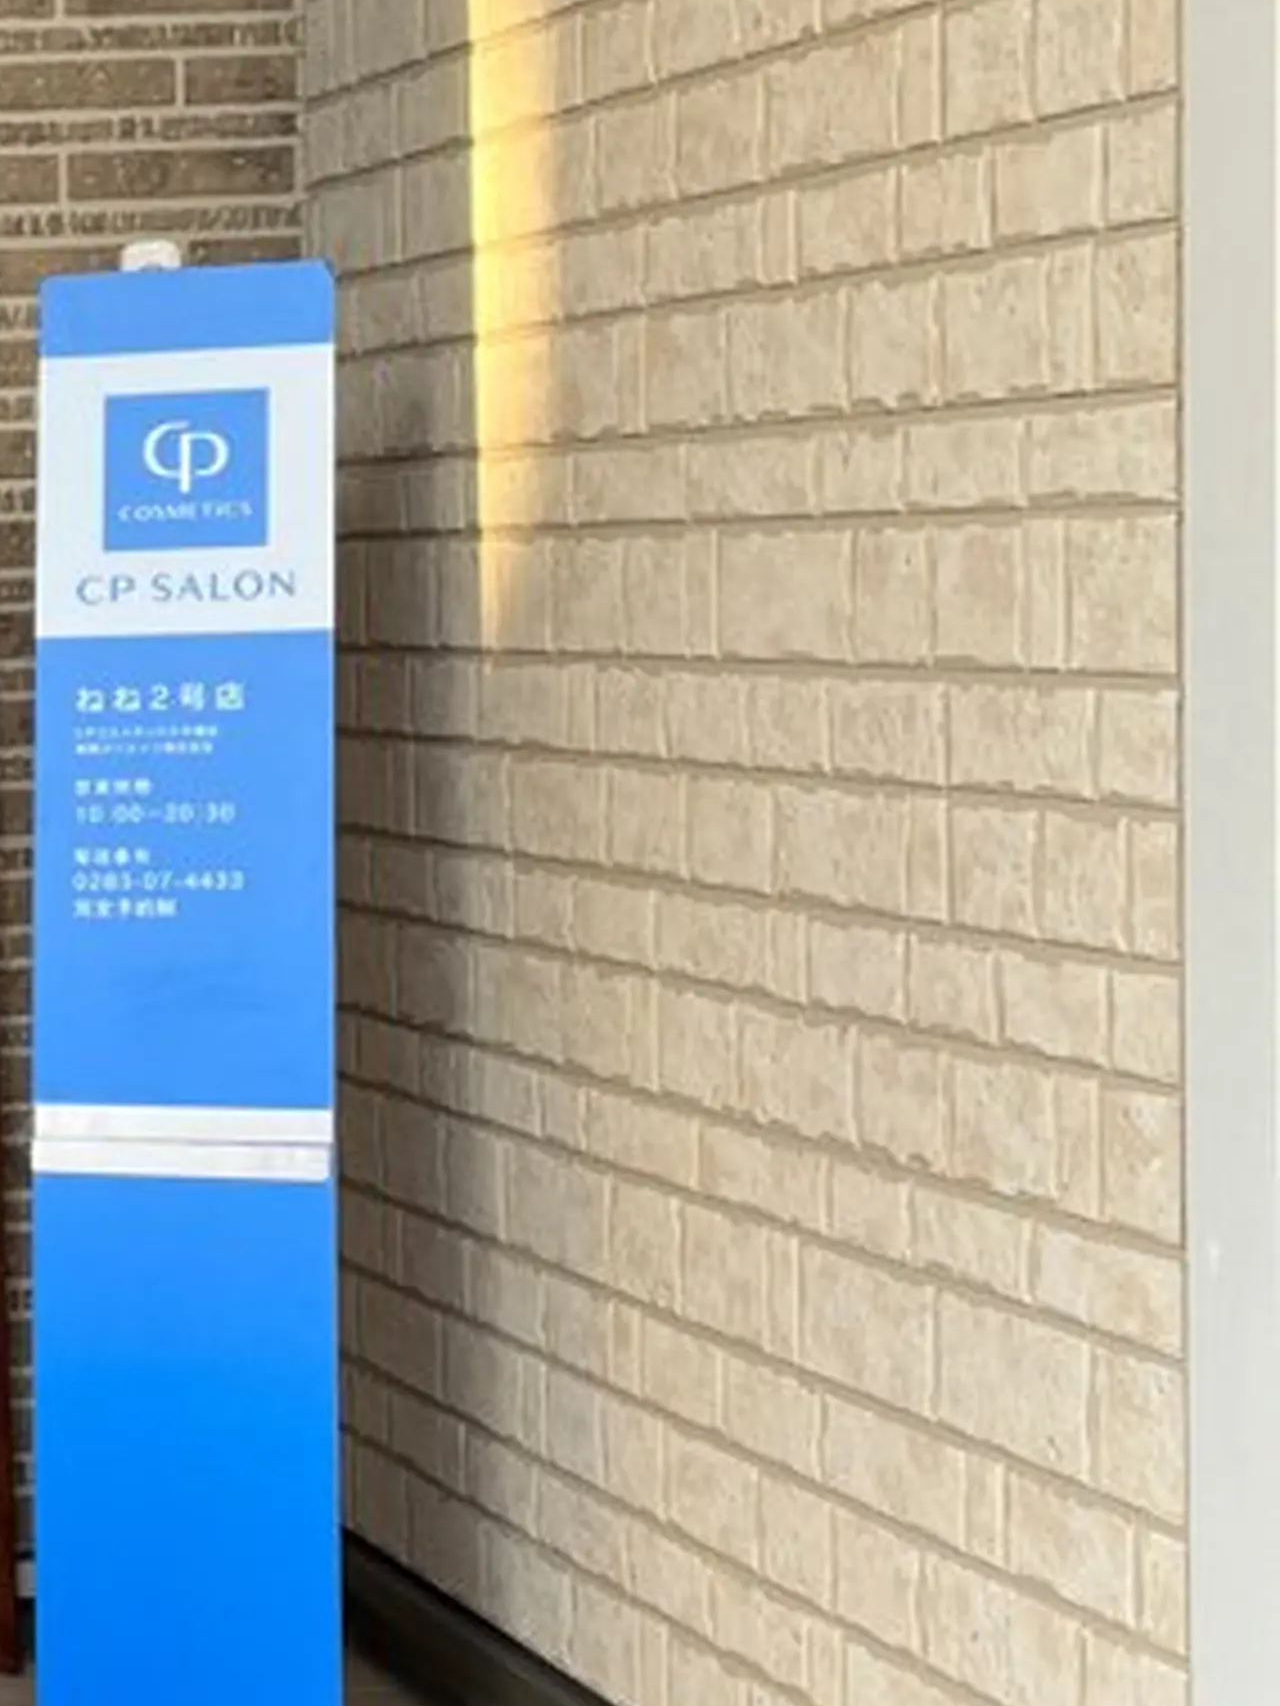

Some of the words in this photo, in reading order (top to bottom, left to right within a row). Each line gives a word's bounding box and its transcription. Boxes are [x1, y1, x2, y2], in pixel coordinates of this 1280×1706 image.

[116, 499, 253, 523] COSMETICS
[75, 574, 136, 607] CP
[150, 568, 297, 603] SALON
